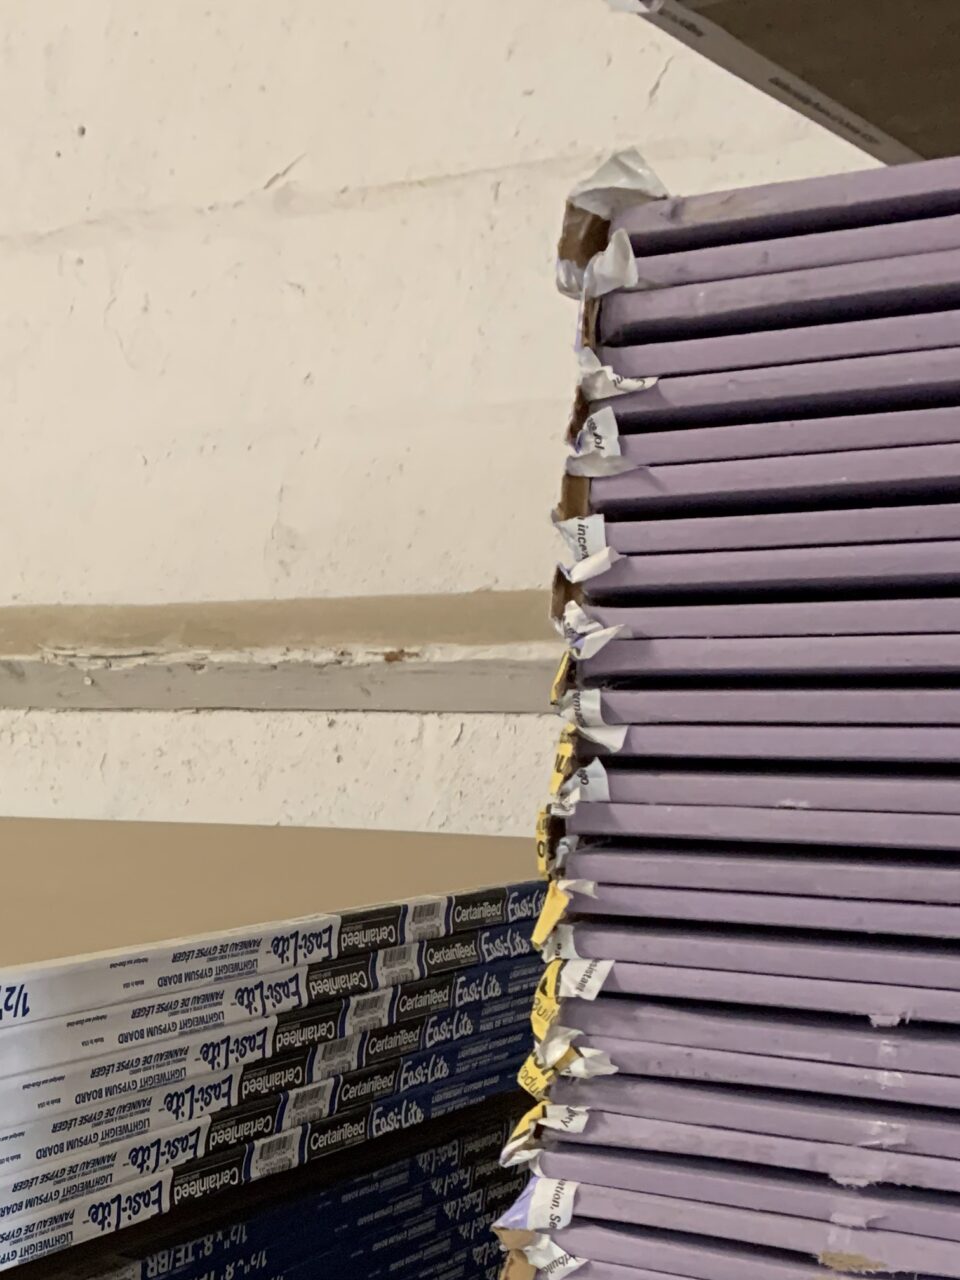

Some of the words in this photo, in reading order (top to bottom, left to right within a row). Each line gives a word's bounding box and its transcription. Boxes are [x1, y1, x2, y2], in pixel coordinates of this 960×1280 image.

[454, 901, 502, 923] CertainTeed
[271, 924, 334, 967] Easi-Lite
[341, 924, 396, 951] CertainTeed
[427, 938, 476, 965] CertainTeed
[481, 929, 530, 963] Easi-Lite
[157, 974, 183, 988] BOARD
[185, 967, 214, 983] GYPSUM
[215, 958, 258, 976] LIGHTWEIGHT
[235, 973, 303, 1017] Easi-Lite
[309, 970, 368, 999] CertainTeed
[399, 985, 449, 1012] CertainTeed
[456, 973, 502, 1007] Easi-Lite
[146, 1022, 177, 1037] GYPSUM
[179, 1011, 224, 1031] LIGHTWEIGHT
[426, 1011, 473, 1048] Easi-Lite
[118, 1030, 145, 1044] BOARD
[199, 1027, 268, 1070] Easi-Lite
[276, 1021, 335, 1052] CertainTeed
[368, 1024, 420, 1054] CertainTeed
[139, 1067, 186, 1088] LIGHTWEIGHT
[242, 1066, 303, 1099] CertainTeed
[341, 1071, 395, 1101] CertainTeed
[401, 1054, 449, 1092] Easi-Lite
[75, 1090, 103, 1105] BOARD
[104, 1081, 137, 1097] GYPSUM
[163, 1074, 233, 1120] Easi-Lite
[101, 1118, 150, 1140] LIGHTWEIGHT
[372, 1099, 424, 1137] Easi-Lite
[66, 1134, 100, 1151] GYPSUM
[210, 1115, 272, 1150] CertainTeed
[310, 1117, 366, 1149] CertainTeed
[36, 1143, 65, 1160] BOARD
[128, 1126, 201, 1174] Easi-Lite
[25, 1189, 60, 1209] GYPSUM
[61, 1173, 113, 1198] LIGHTWEIGHT
[174, 1167, 239, 1205] CertainTeed
[88, 1180, 163, 1231] Easi-Lite
[19, 1231, 73, 1258] LIGHTWEIGHT
